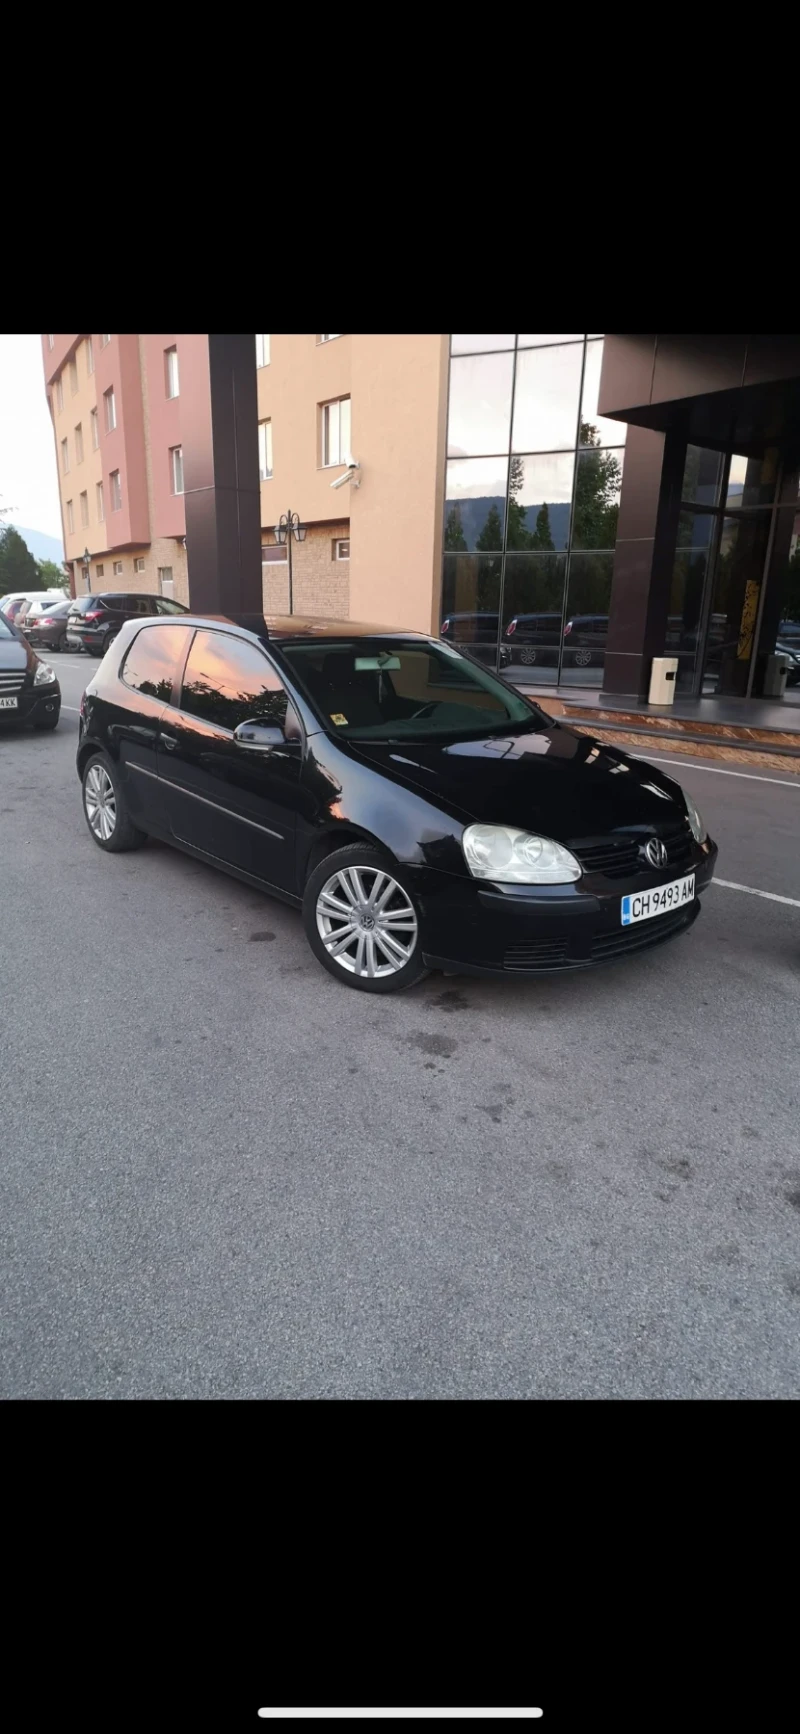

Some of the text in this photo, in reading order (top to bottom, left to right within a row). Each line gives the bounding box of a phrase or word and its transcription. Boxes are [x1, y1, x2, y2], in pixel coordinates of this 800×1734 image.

[6, 698, 16, 706] KK
[632, 878, 694, 918] CH 9493 AM
